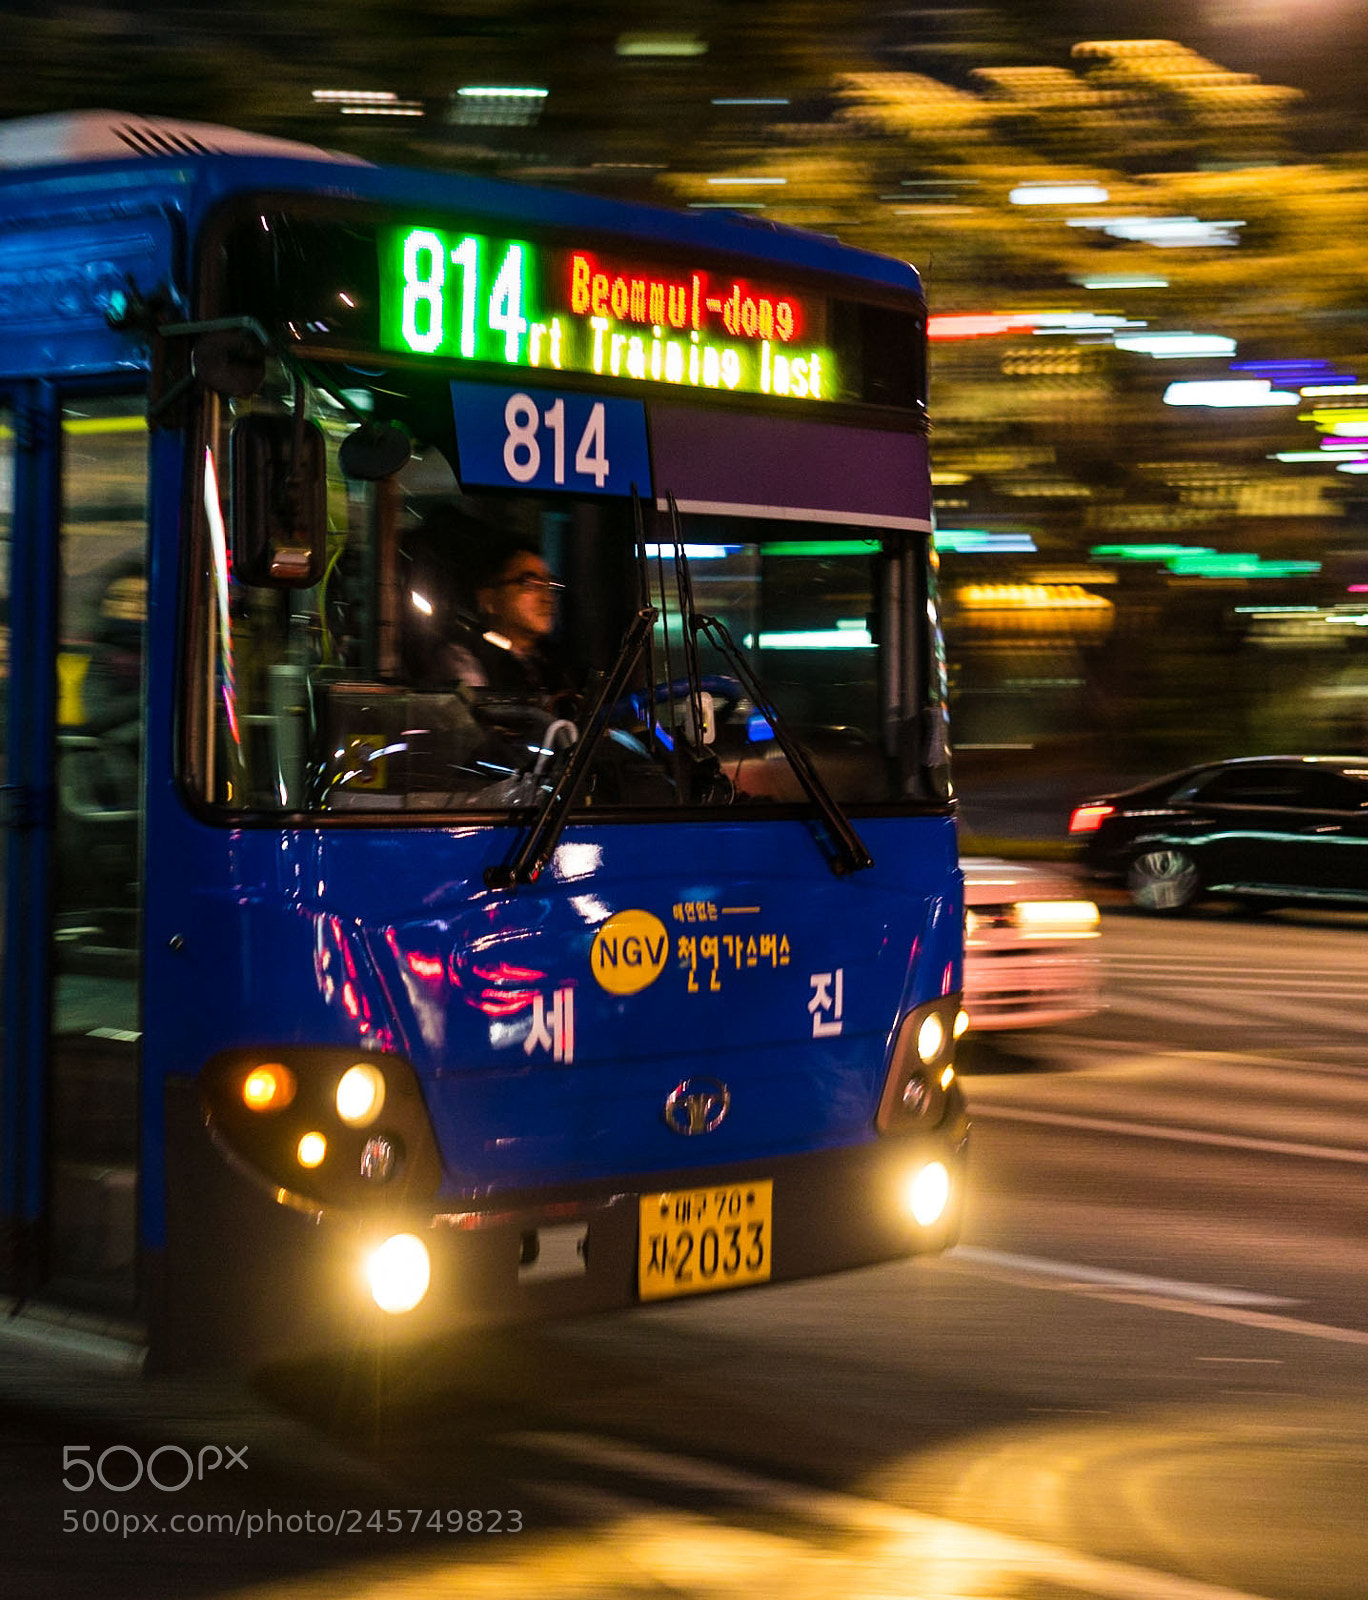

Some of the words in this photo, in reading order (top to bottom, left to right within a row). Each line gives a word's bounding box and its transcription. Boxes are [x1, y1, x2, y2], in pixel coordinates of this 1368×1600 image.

[401, 227, 528, 363] 814
[571, 255, 795, 342] Beommul-dong
[590, 315, 742, 391] Training
[503, 392, 610, 488] 814
[599, 934, 666, 969] NGV
[523, 986, 575, 1065] 세
[807, 967, 844, 1039] 진
